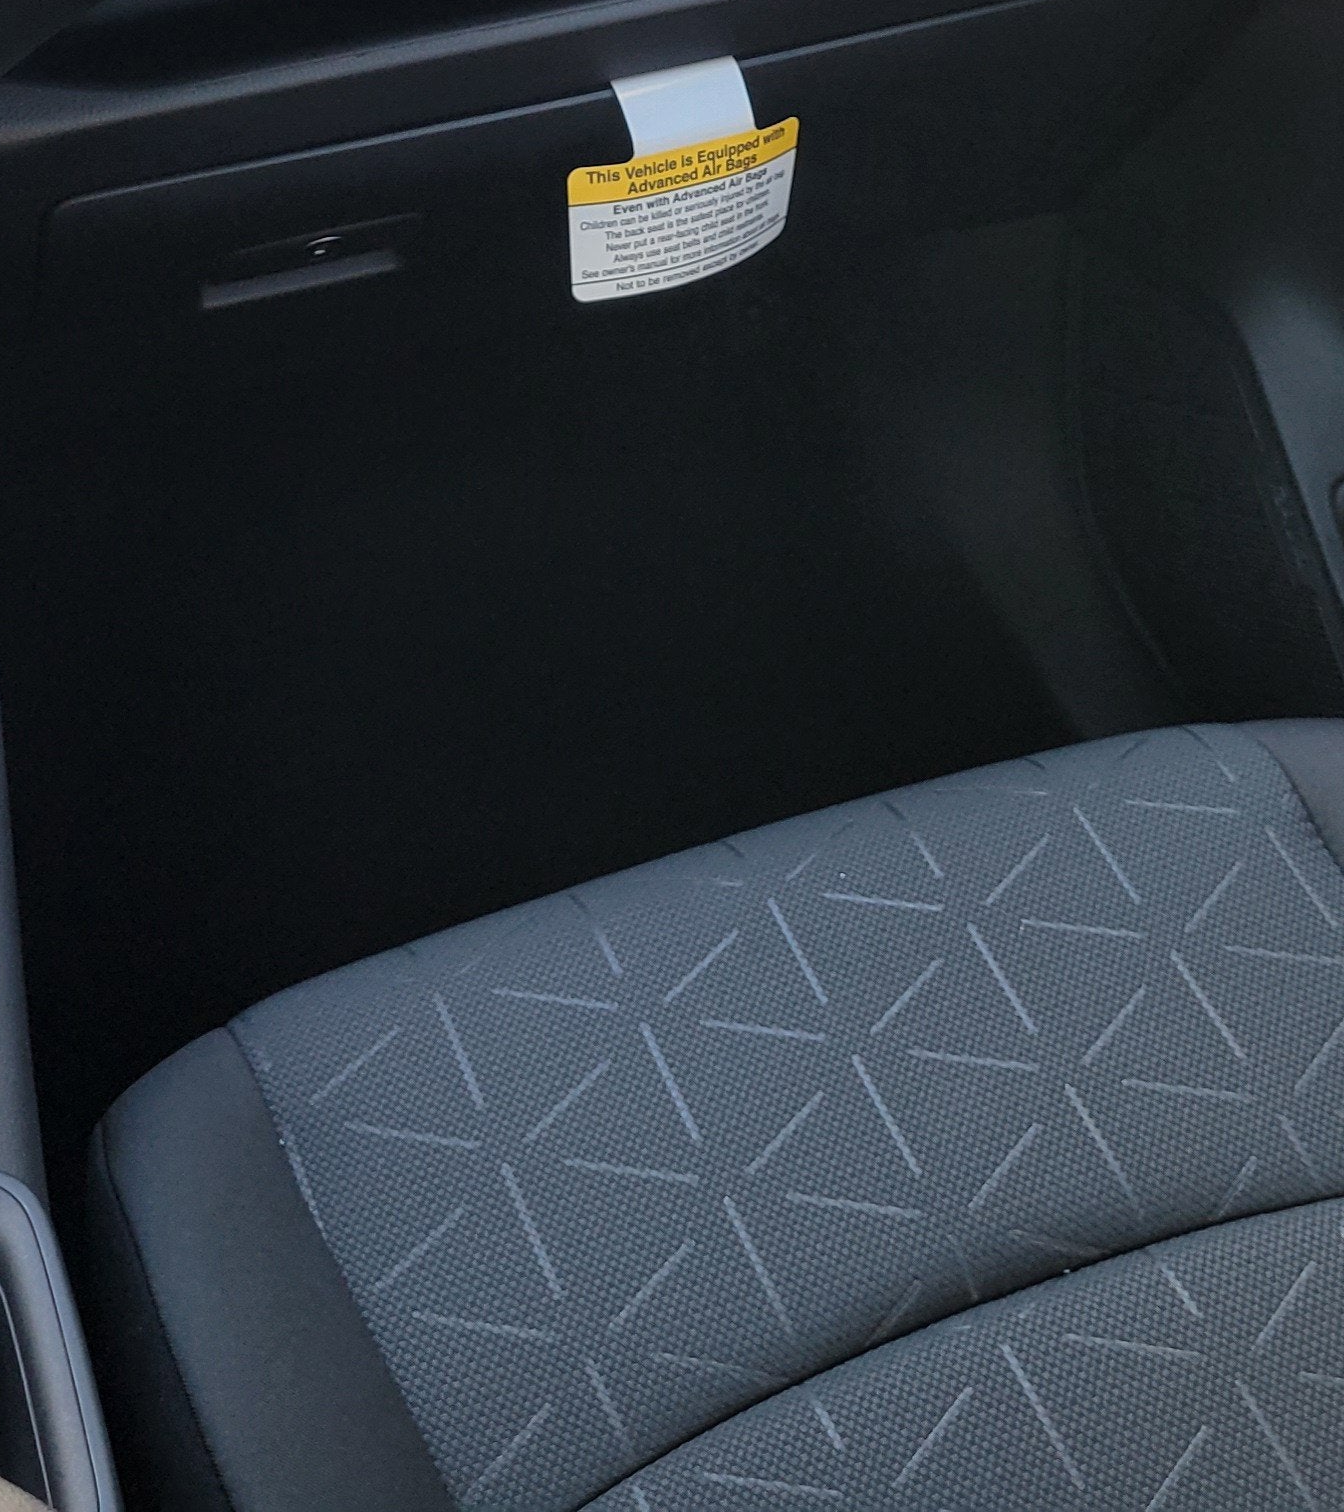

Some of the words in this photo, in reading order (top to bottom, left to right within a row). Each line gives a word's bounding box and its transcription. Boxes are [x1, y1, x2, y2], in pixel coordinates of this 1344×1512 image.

[586, 169, 620, 184] This
[625, 159, 677, 180] Vehicle
[681, 155, 693, 168] is
[697, 135, 760, 166] Equipped
[763, 127, 785, 144] with
[627, 167, 698, 196] Advanced
[702, 160, 722, 178] Air
[725, 153, 757, 173] Bags
[613, 202, 643, 215] Even
[646, 196, 670, 210] with
[673, 181, 726, 203] Advanced
[728, 176, 743, 189] Air
[745, 168, 767, 184] Bags
[580, 219, 618, 231] Children
[620, 217, 636, 226] can
[638, 213, 649, 223] be
[651, 208, 672, 220] killed
[605, 230, 622, 240] The
[624, 226, 645, 238] back
[647, 223, 665, 234] seat
[605, 241, 631, 252] Never
[634, 238, 647, 249] put
[613, 250, 644, 264] Always
[581, 269, 599, 279] See
[616, 281, 634, 291] Not
[636, 279, 646, 289] to
[648, 276, 660, 287] be
